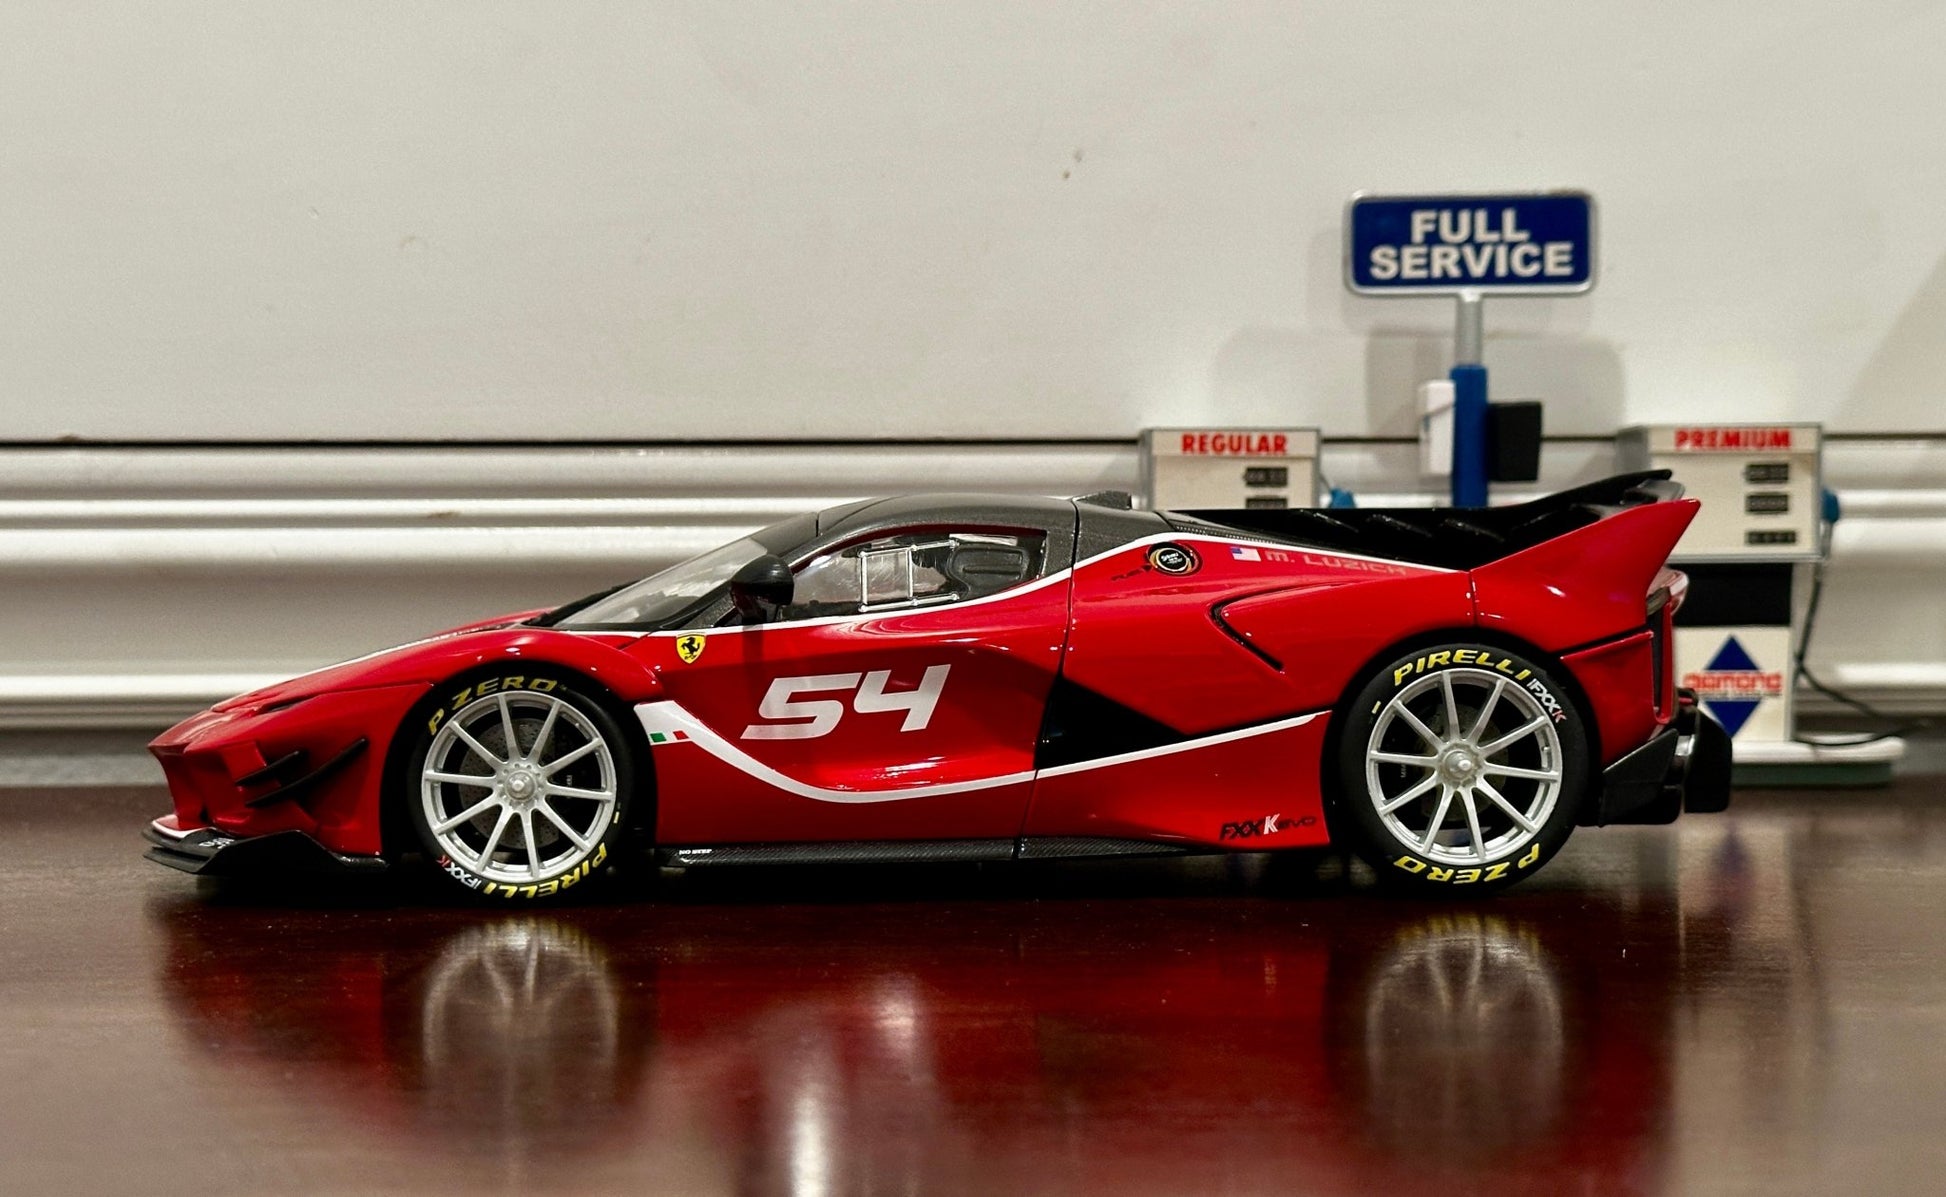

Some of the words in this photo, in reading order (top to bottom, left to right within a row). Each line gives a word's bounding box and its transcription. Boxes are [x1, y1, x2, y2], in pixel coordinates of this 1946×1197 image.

[1411, 208, 1530, 244] FULL
[1370, 242, 1574, 280] SERVICE
[1181, 434, 1287, 454] REGULAR
[1675, 429, 1791, 448] PREMIUM
[1303, 554, 1407, 576] LUZICH
[1394, 649, 1532, 686] PIRELLI
[428, 708, 445, 736] P
[452, 675, 558, 710] ZERO
[740, 664, 951, 740] 54
[483, 842, 608, 898] PIRELLI
[1393, 855, 1511, 884] ZERO
[1517, 843, 1540, 869] P
